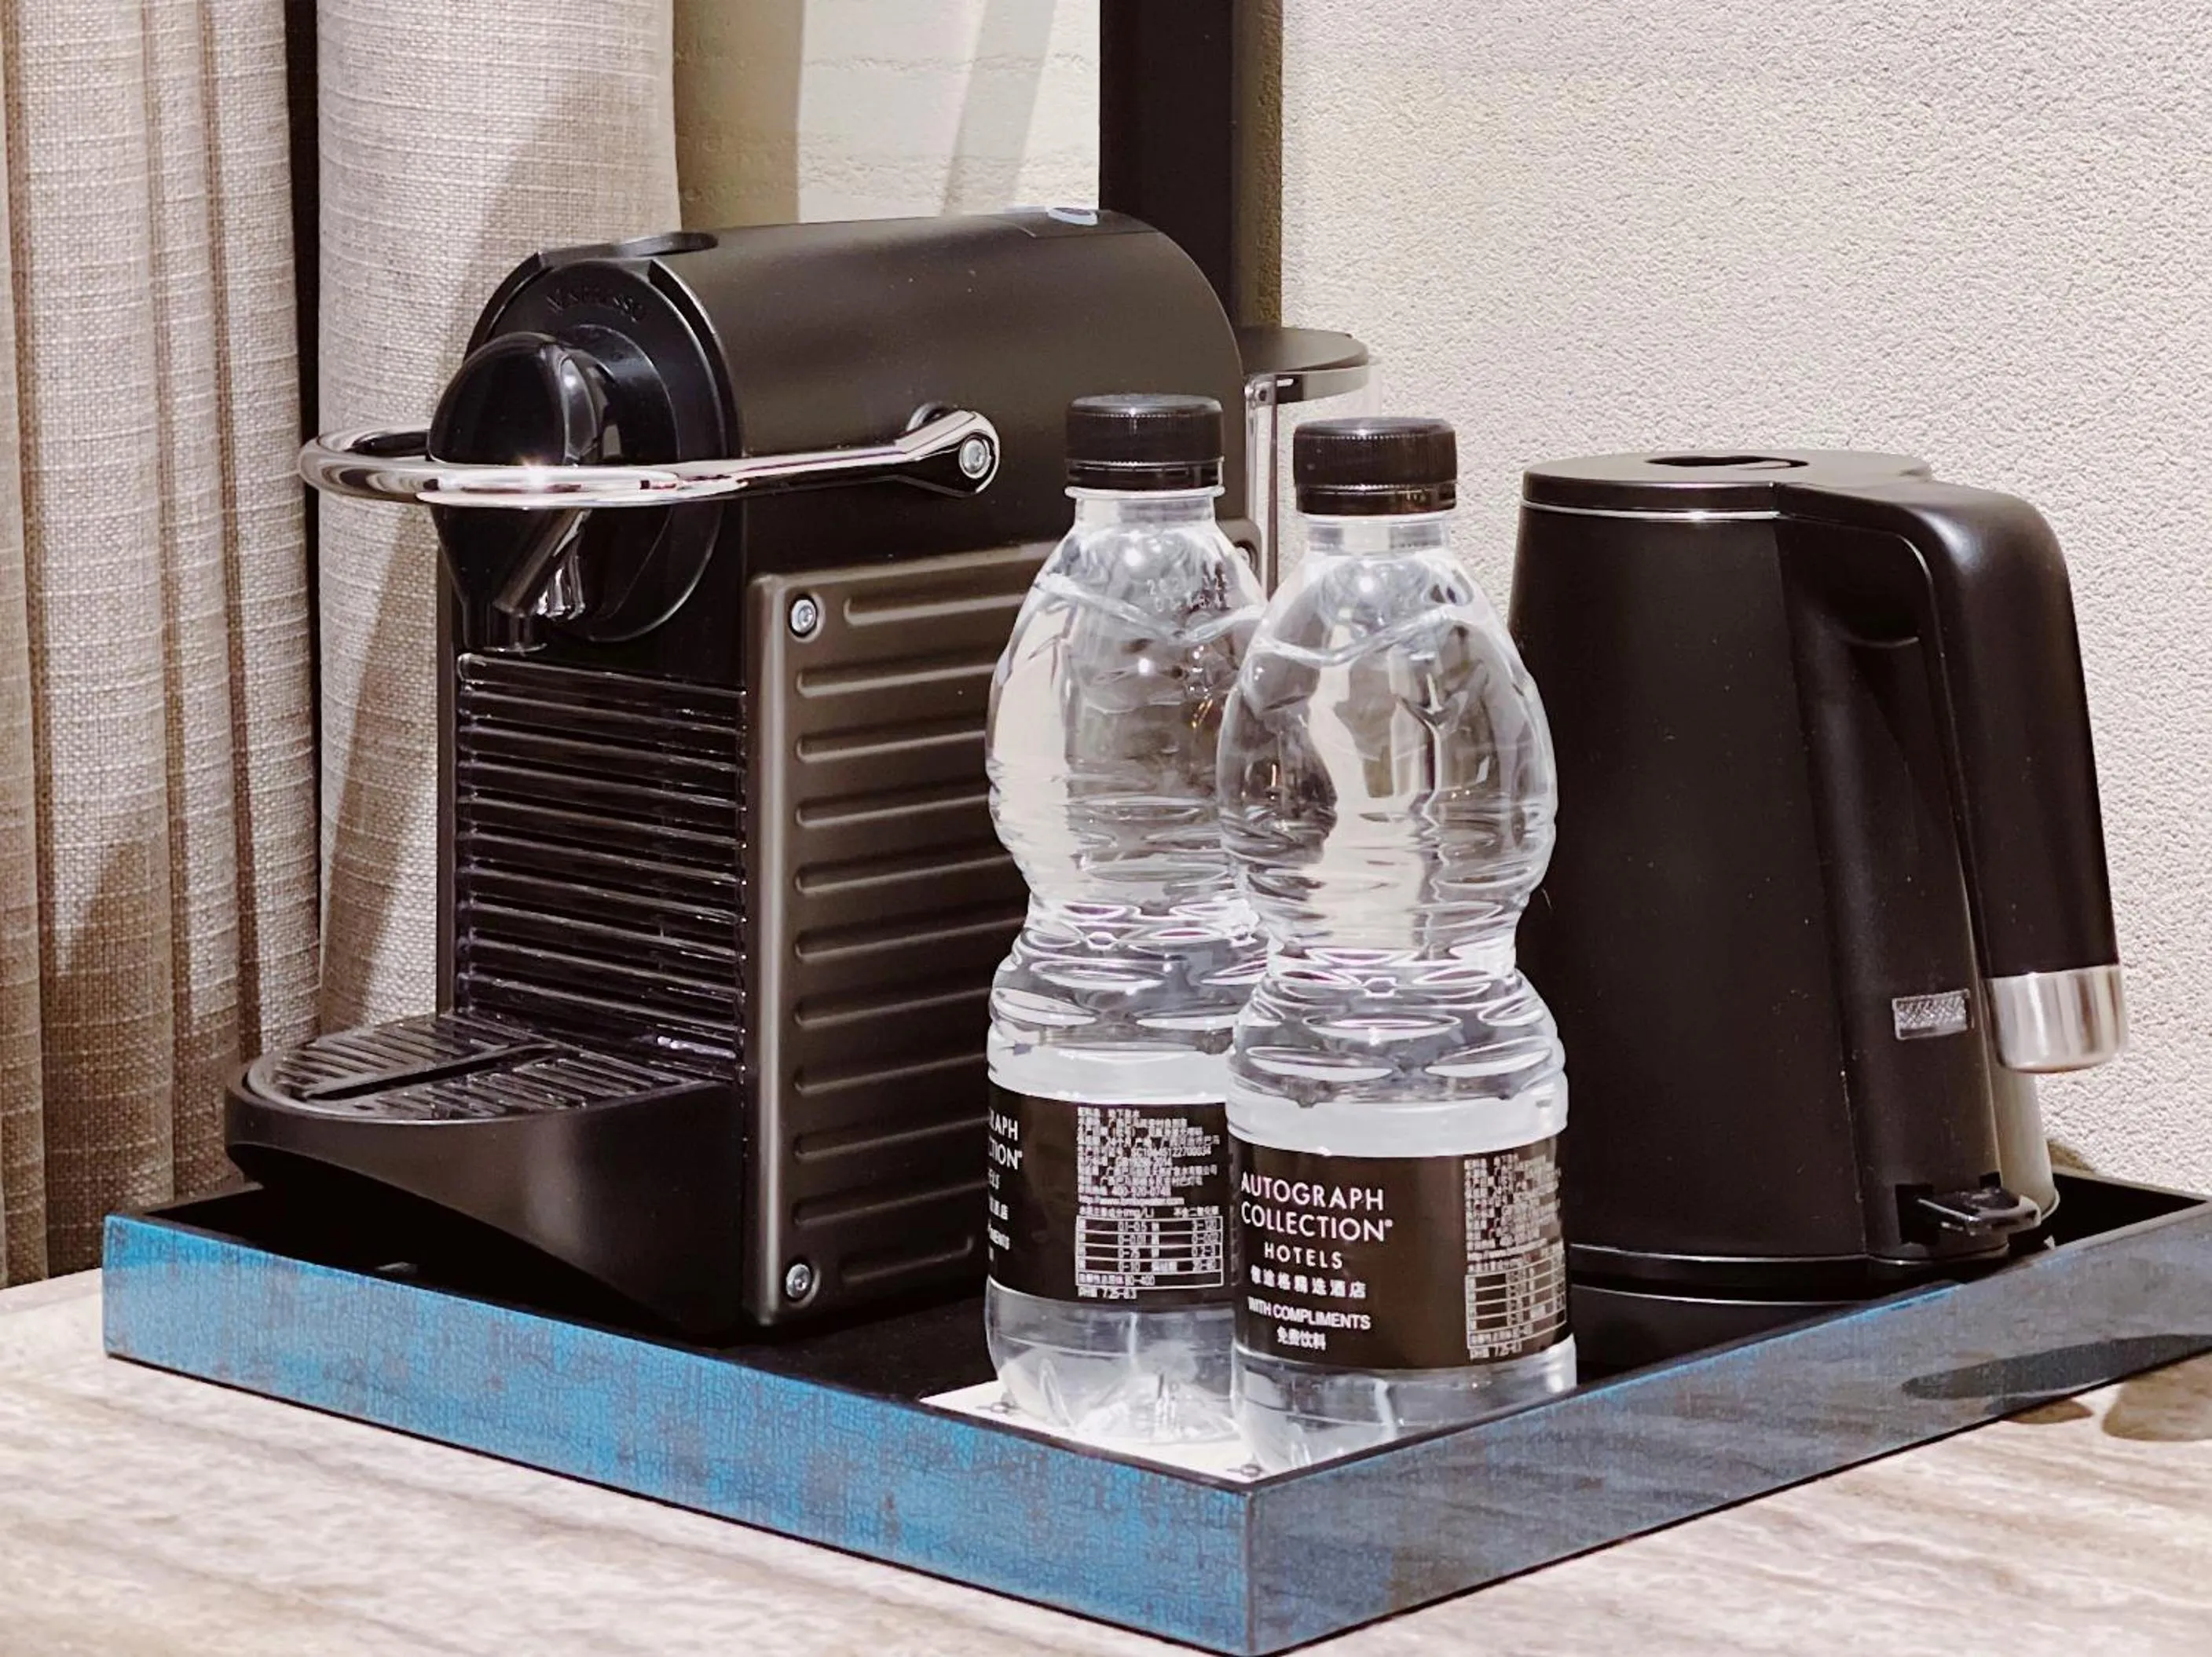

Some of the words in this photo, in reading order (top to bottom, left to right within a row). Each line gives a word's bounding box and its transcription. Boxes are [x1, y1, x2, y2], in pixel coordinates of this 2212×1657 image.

[1241, 1171, 1384, 1211] AUTOGRAPH
[1264, 1241, 1342, 1269] HOTELS
[1247, 1296, 1272, 1316] WITH
[1273, 1304, 1372, 1330] COMPLIMENTS
